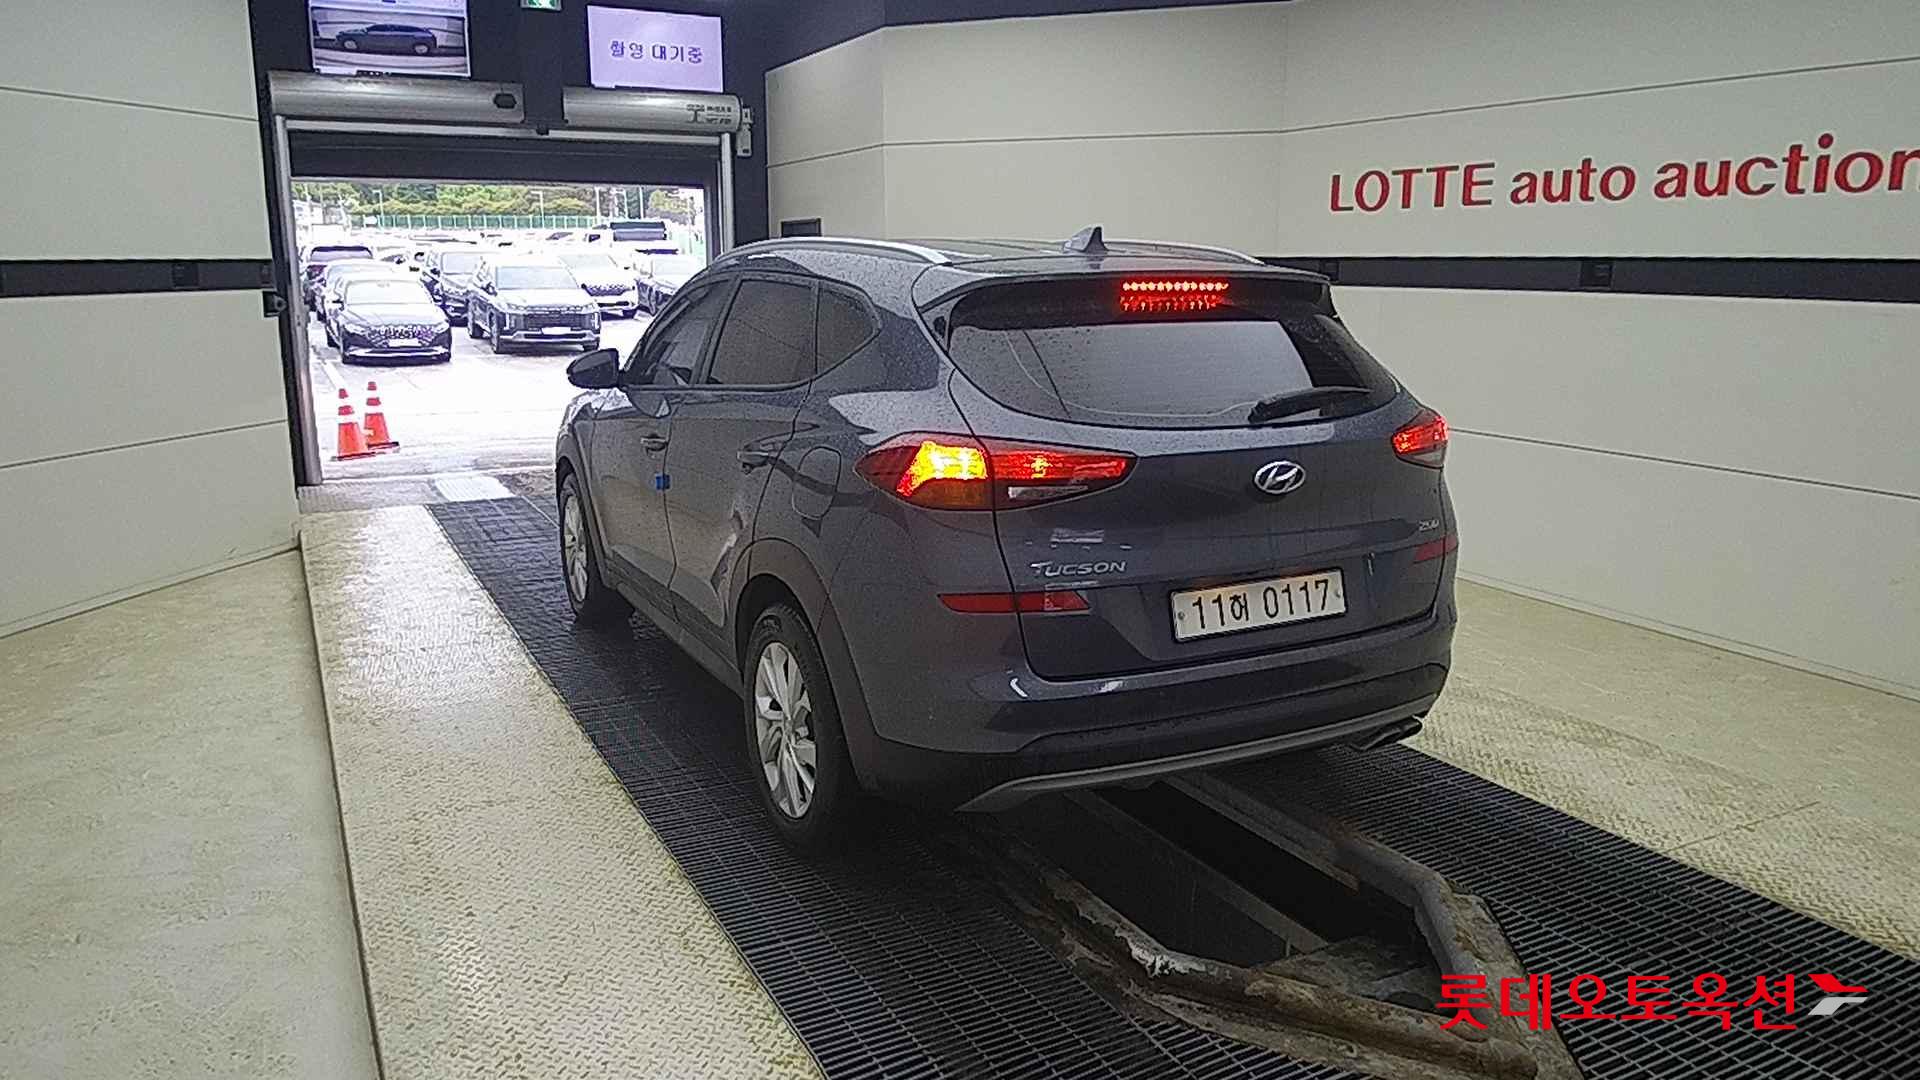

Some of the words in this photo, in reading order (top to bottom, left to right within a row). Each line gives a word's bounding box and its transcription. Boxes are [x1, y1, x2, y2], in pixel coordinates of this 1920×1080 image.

[651, 43, 703, 64] 대기중
[1329, 161, 1496, 212] LOTTE
[1509, 156, 1637, 205] auto
[1029, 560, 1127, 577] TUCSON
[1191, 591, 1250, 630] 11허
[1262, 578, 1329, 619] 0117
